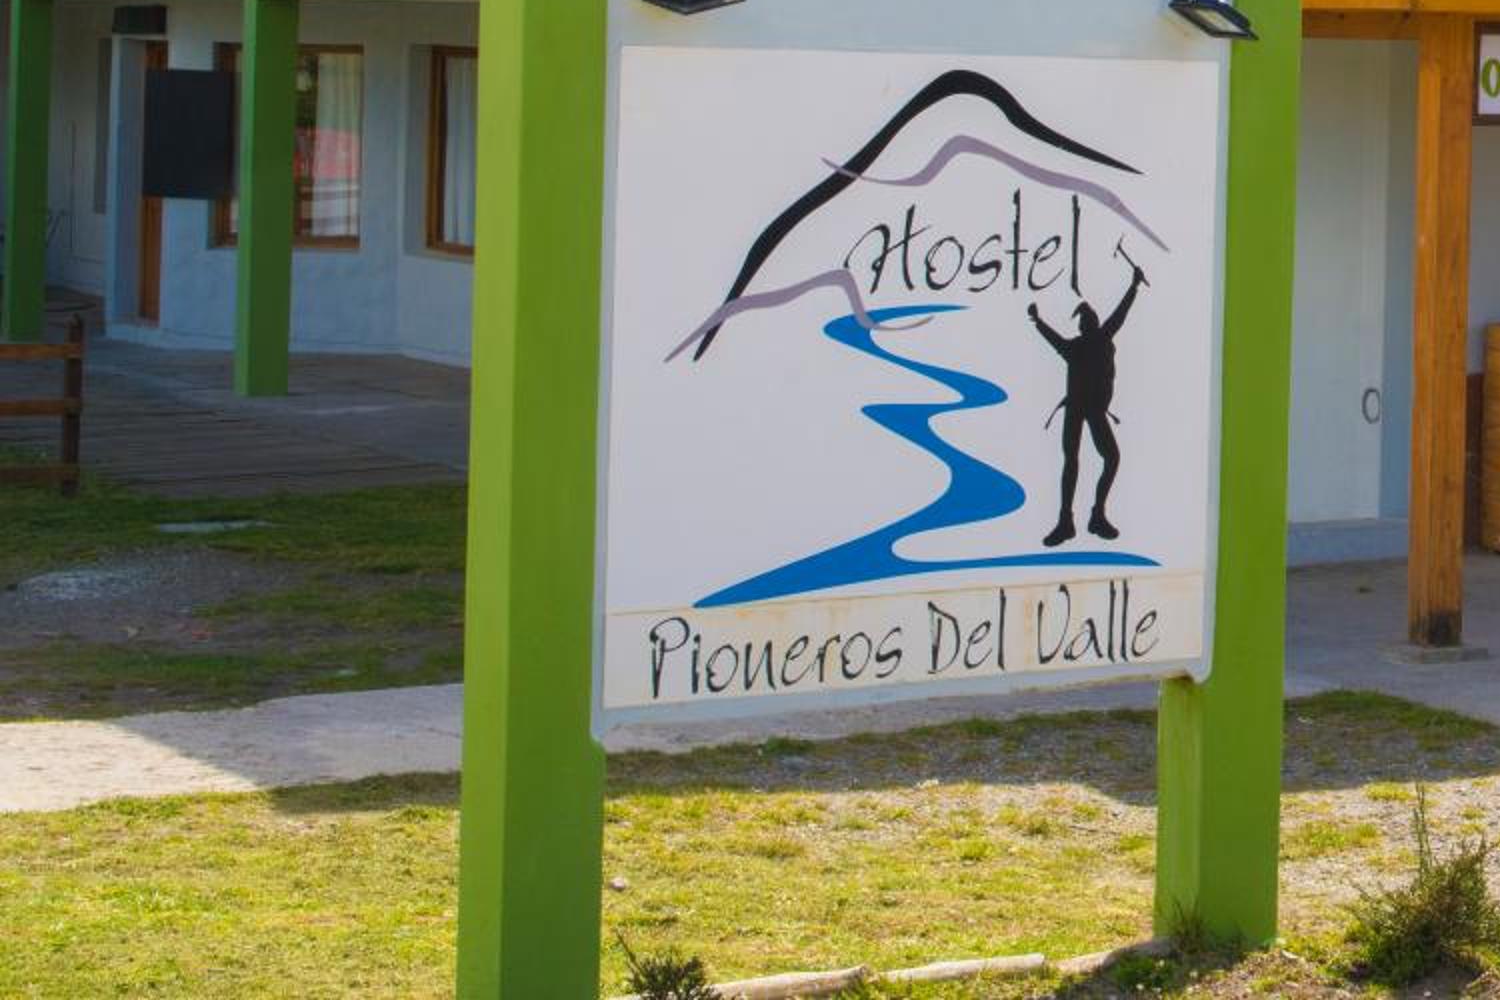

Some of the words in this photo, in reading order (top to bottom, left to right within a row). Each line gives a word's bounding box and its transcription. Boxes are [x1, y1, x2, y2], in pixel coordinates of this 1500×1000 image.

[843, 187, 1083, 299] Hostel
[649, 616, 903, 699] Pioneros
[926, 588, 1007, 675] Del
[1036, 579, 1158, 665] Valle
